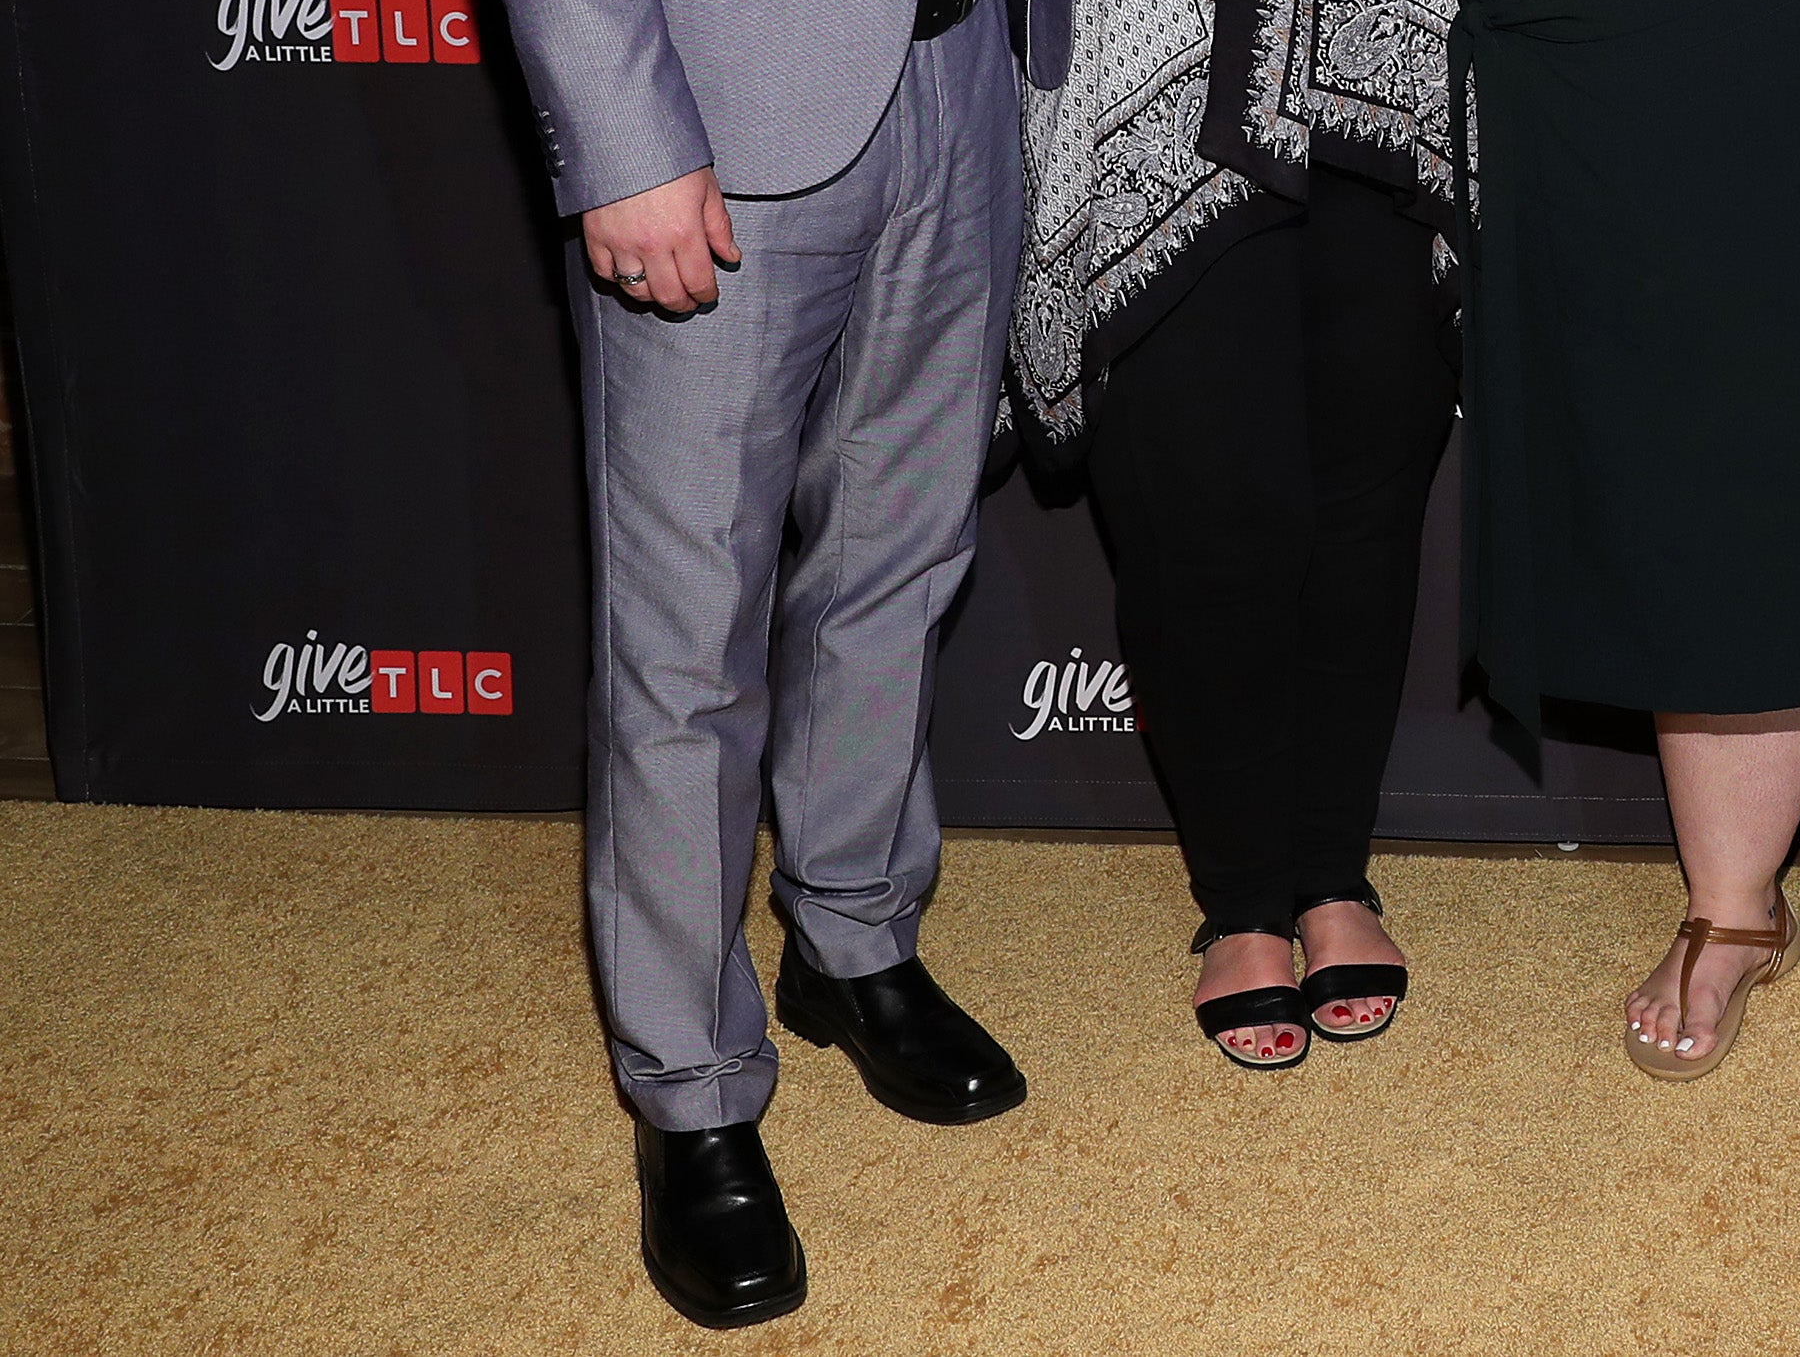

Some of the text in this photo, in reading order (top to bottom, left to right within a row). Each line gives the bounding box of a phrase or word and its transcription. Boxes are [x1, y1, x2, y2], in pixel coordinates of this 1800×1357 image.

[339, 10, 470, 47] TLC
[245, 45, 332, 62] A LITTLE
[250, 629, 374, 722] give
[378, 667, 503, 700] TLC
[287, 698, 370, 713] A LITTLE
[1008, 647, 1134, 741] give
[1047, 716, 1135, 732] A LITTLE
